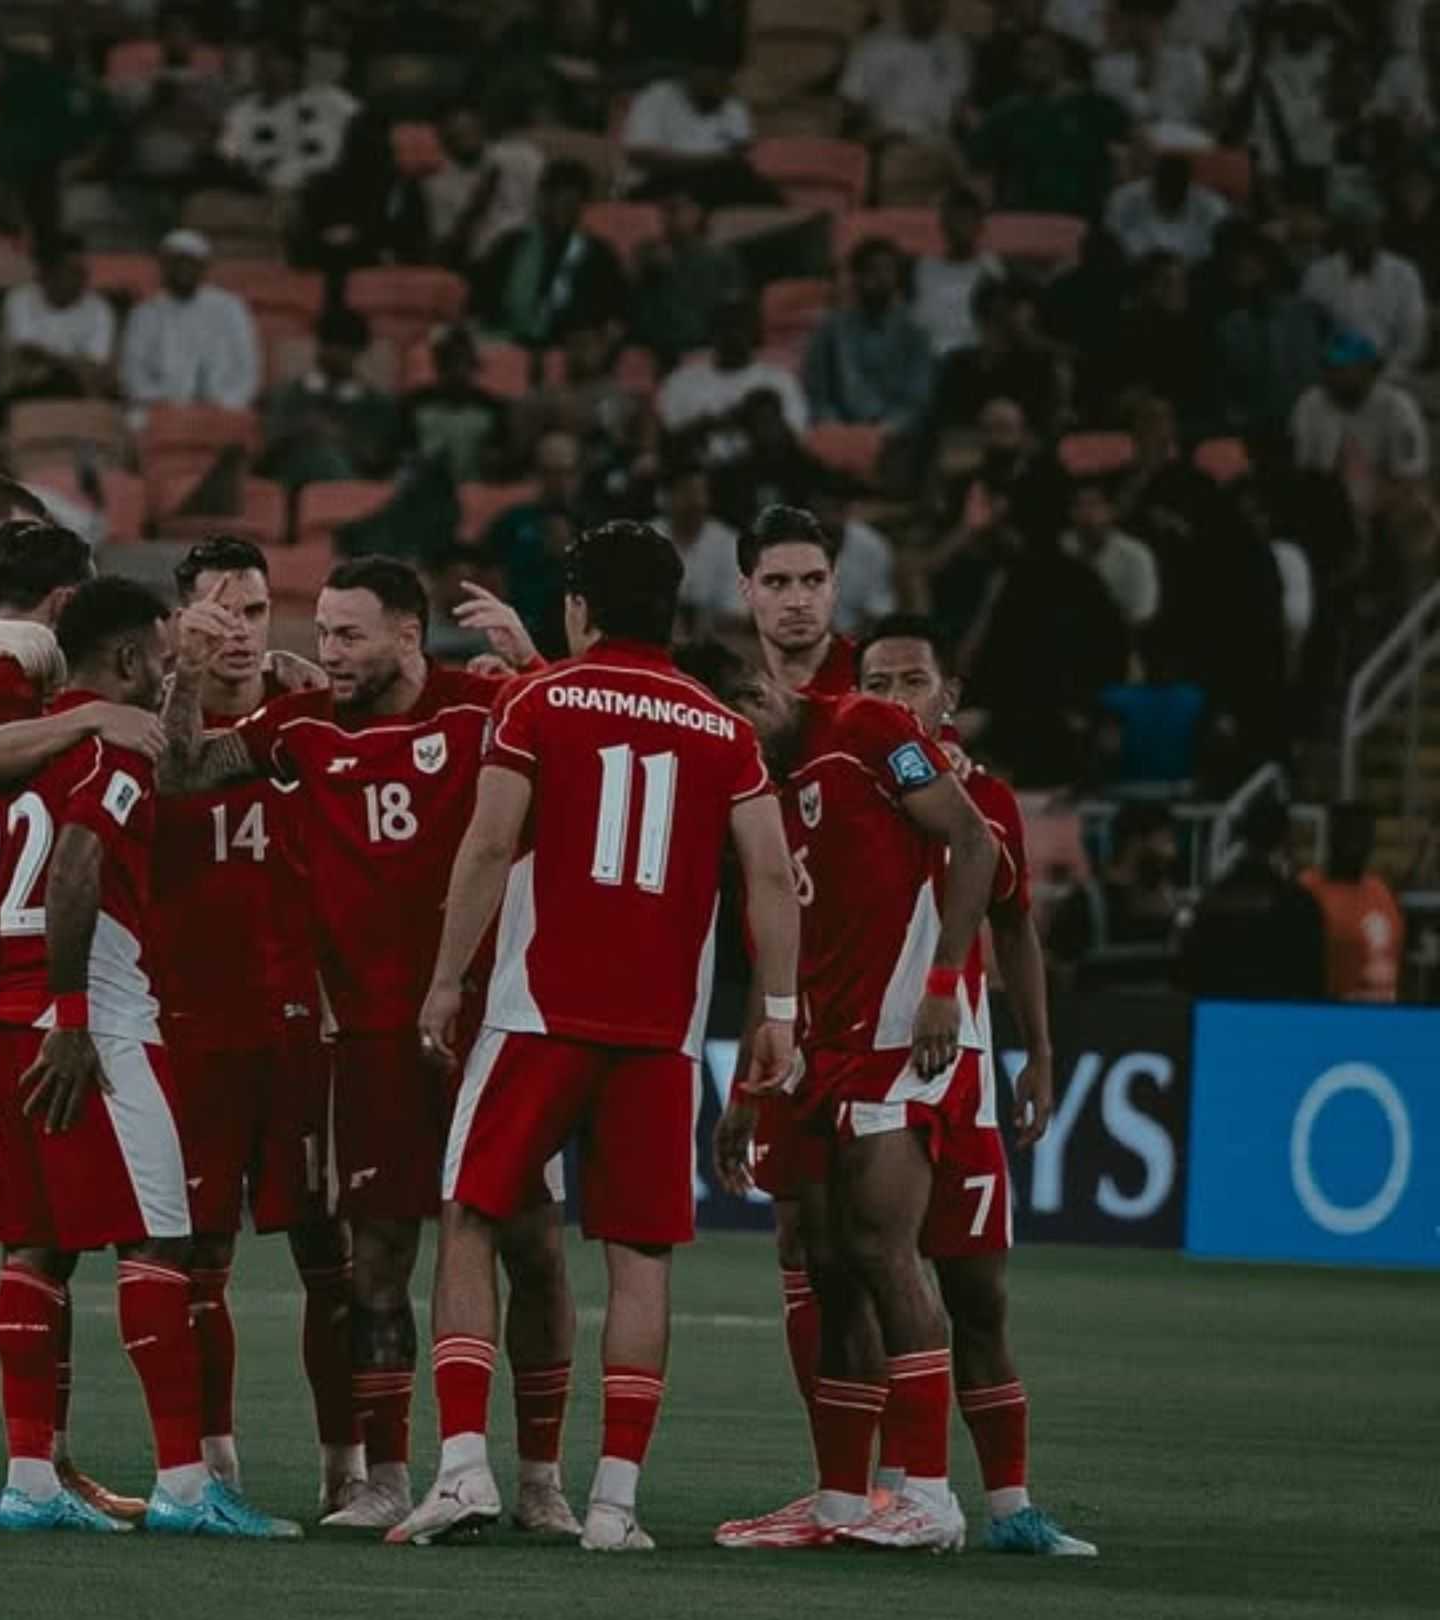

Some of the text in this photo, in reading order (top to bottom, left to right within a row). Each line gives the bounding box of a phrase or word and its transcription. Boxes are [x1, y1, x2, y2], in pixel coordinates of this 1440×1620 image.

[547, 684, 736, 741] ORATMANGOEN
[211, 801, 271, 862] 14
[363, 781, 418, 843] 18
[591, 743, 679, 894] 11
[964, 1174, 996, 1237] 7
